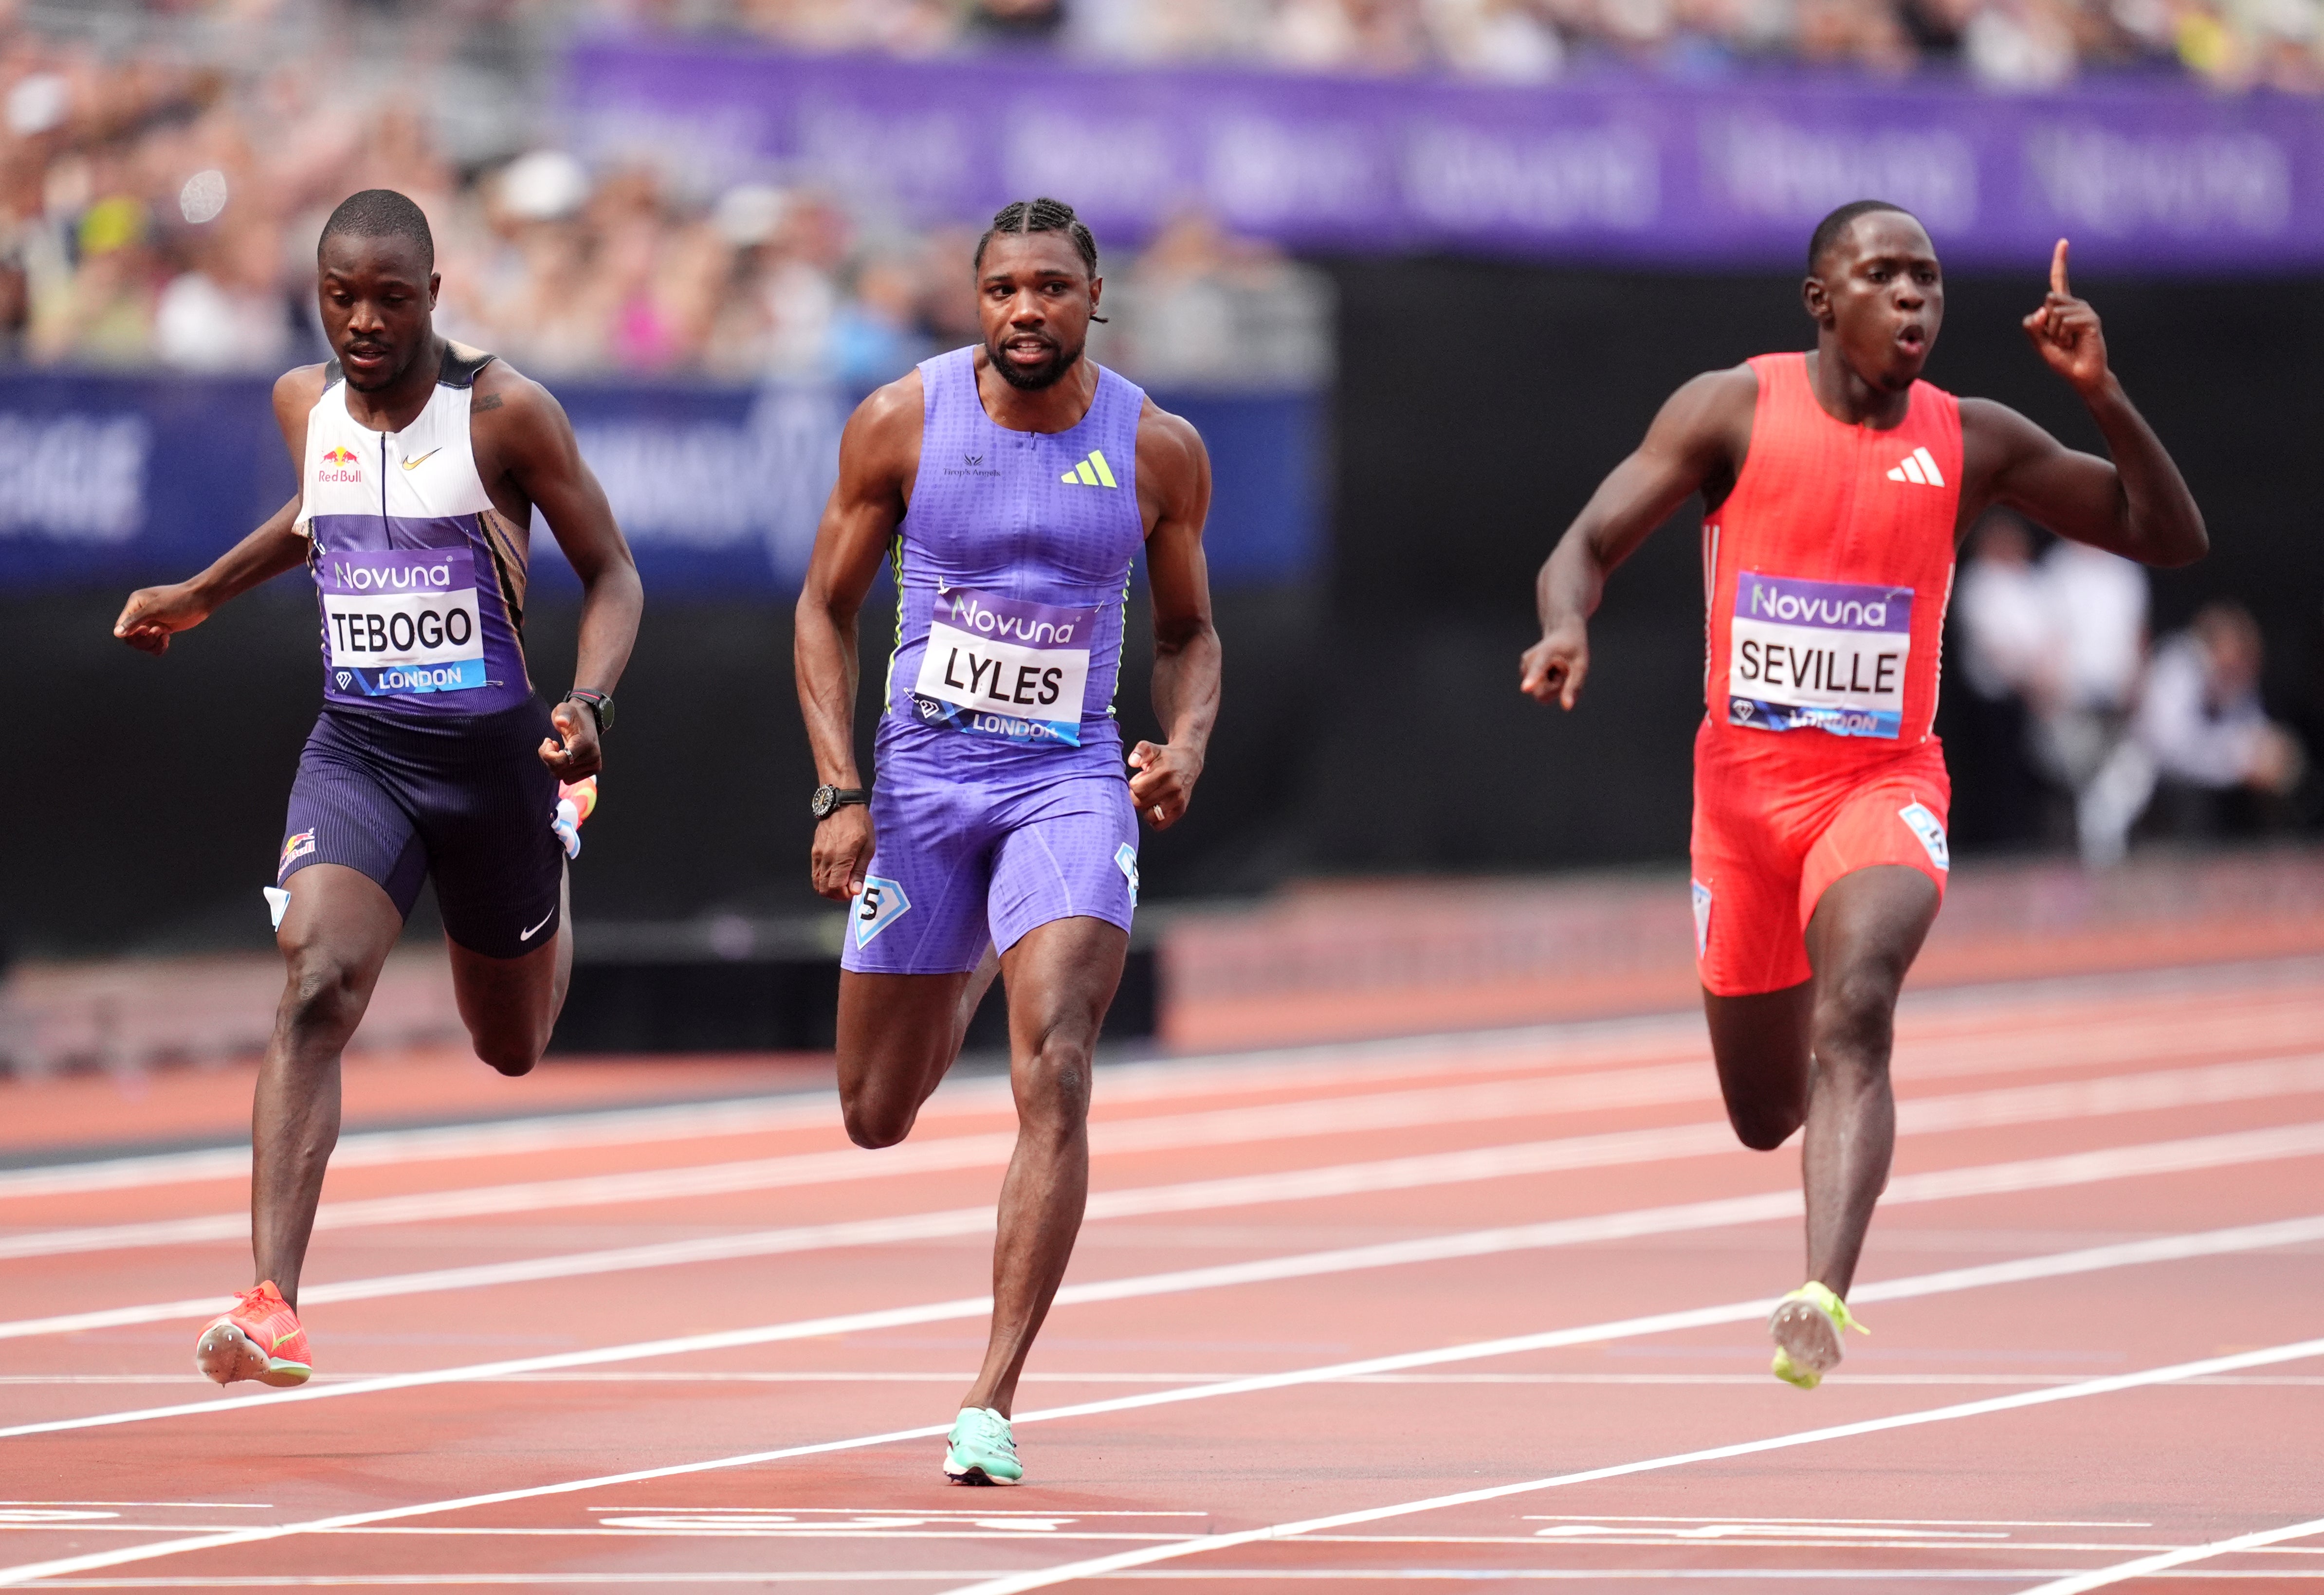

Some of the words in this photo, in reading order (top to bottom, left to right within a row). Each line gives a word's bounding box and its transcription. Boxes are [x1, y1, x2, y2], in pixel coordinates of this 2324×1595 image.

[319, 470, 338, 482] Red
[340, 470, 361, 482] Bull
[973, 469, 1001, 477] Angels
[1752, 584, 1887, 627] Novuna
[331, 607, 472, 652] TEBOGO
[379, 668, 462, 690] LONDON
[944, 647, 1062, 705] LYLES
[1740, 640, 1898, 693] SEVILLE
[973, 713, 1059, 739] LONDON
[290, 841, 314, 861] Bull
[860, 887, 880, 921] 5
